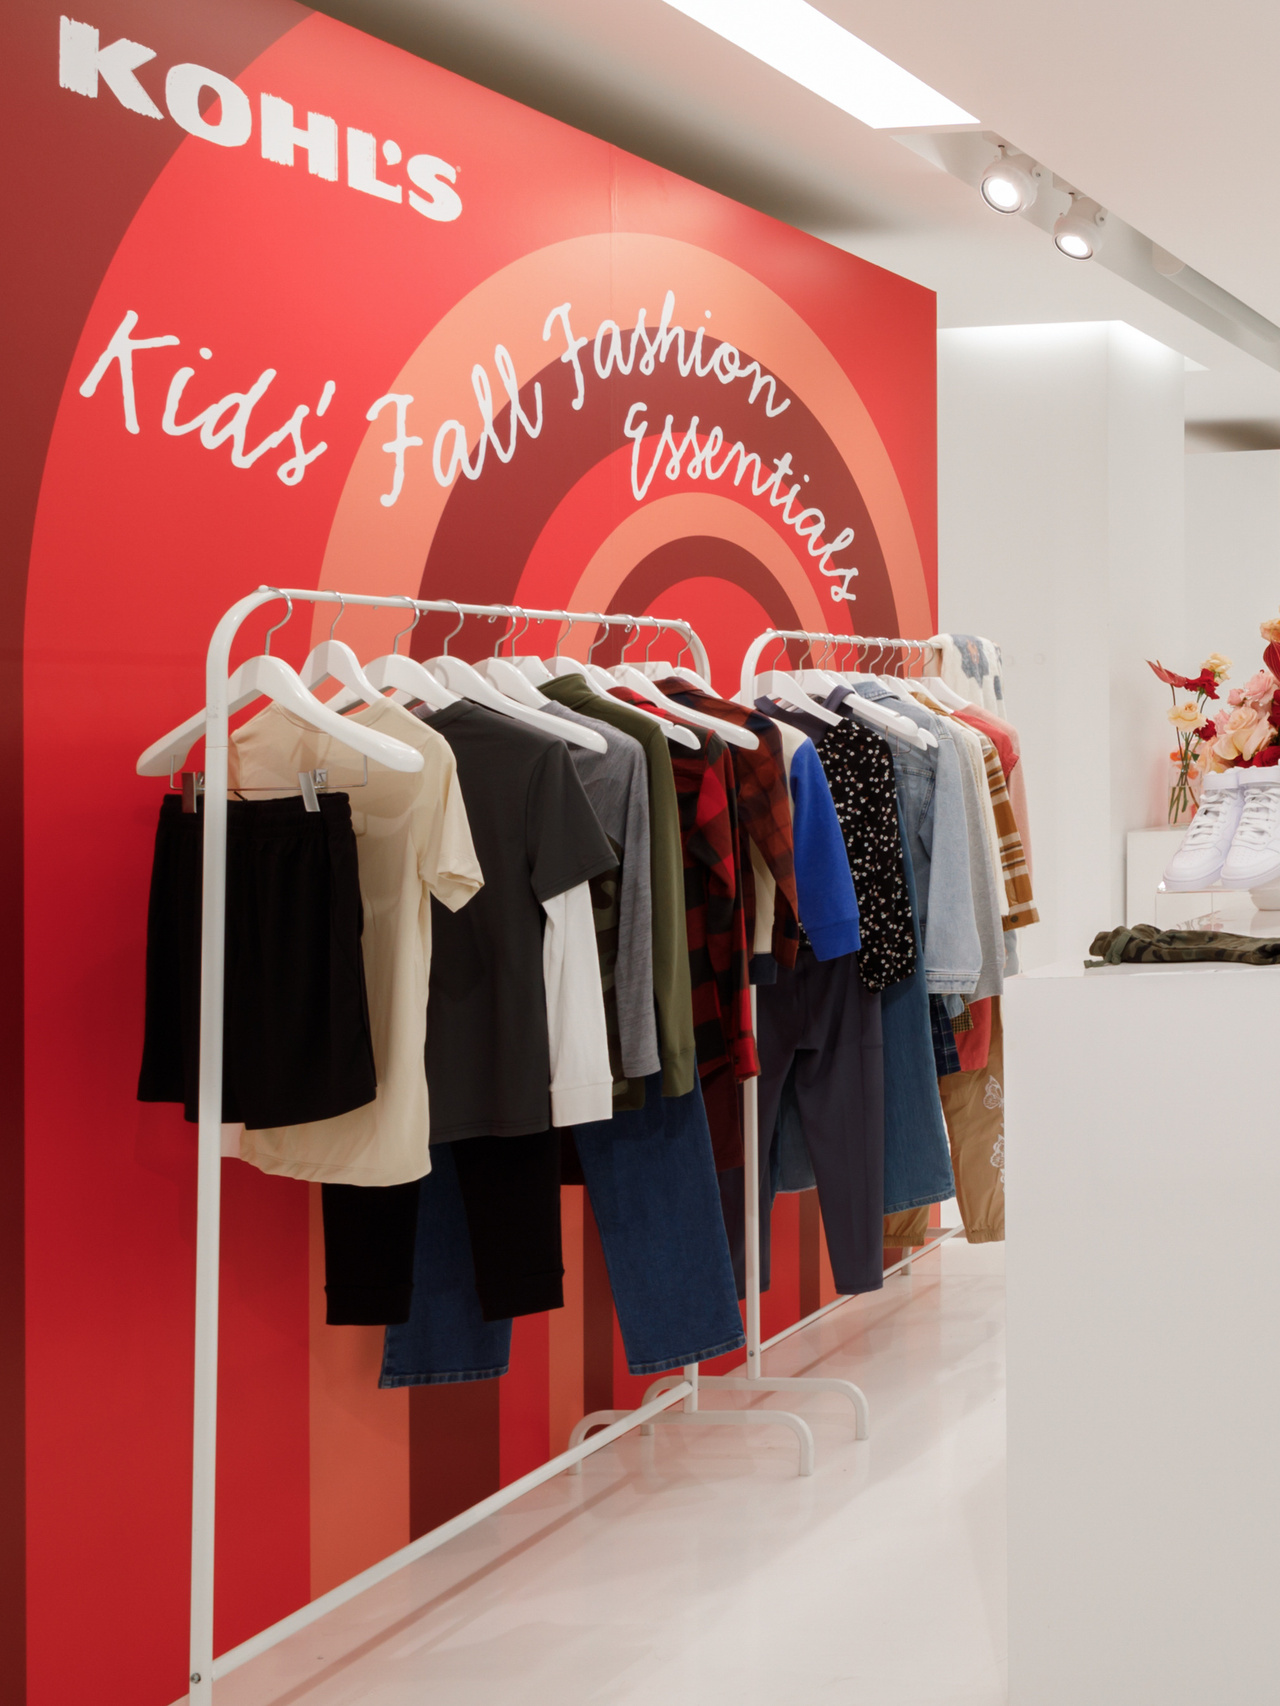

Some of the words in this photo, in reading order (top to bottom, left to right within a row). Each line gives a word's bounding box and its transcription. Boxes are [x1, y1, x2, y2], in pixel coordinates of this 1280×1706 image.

[58, 15, 463, 223] KOHL'S
[79, 310, 336, 486] Kids'
[366, 343, 543, 508] Fall
[541, 289, 791, 418] Fashion
[623, 401, 859, 602] Essentials
